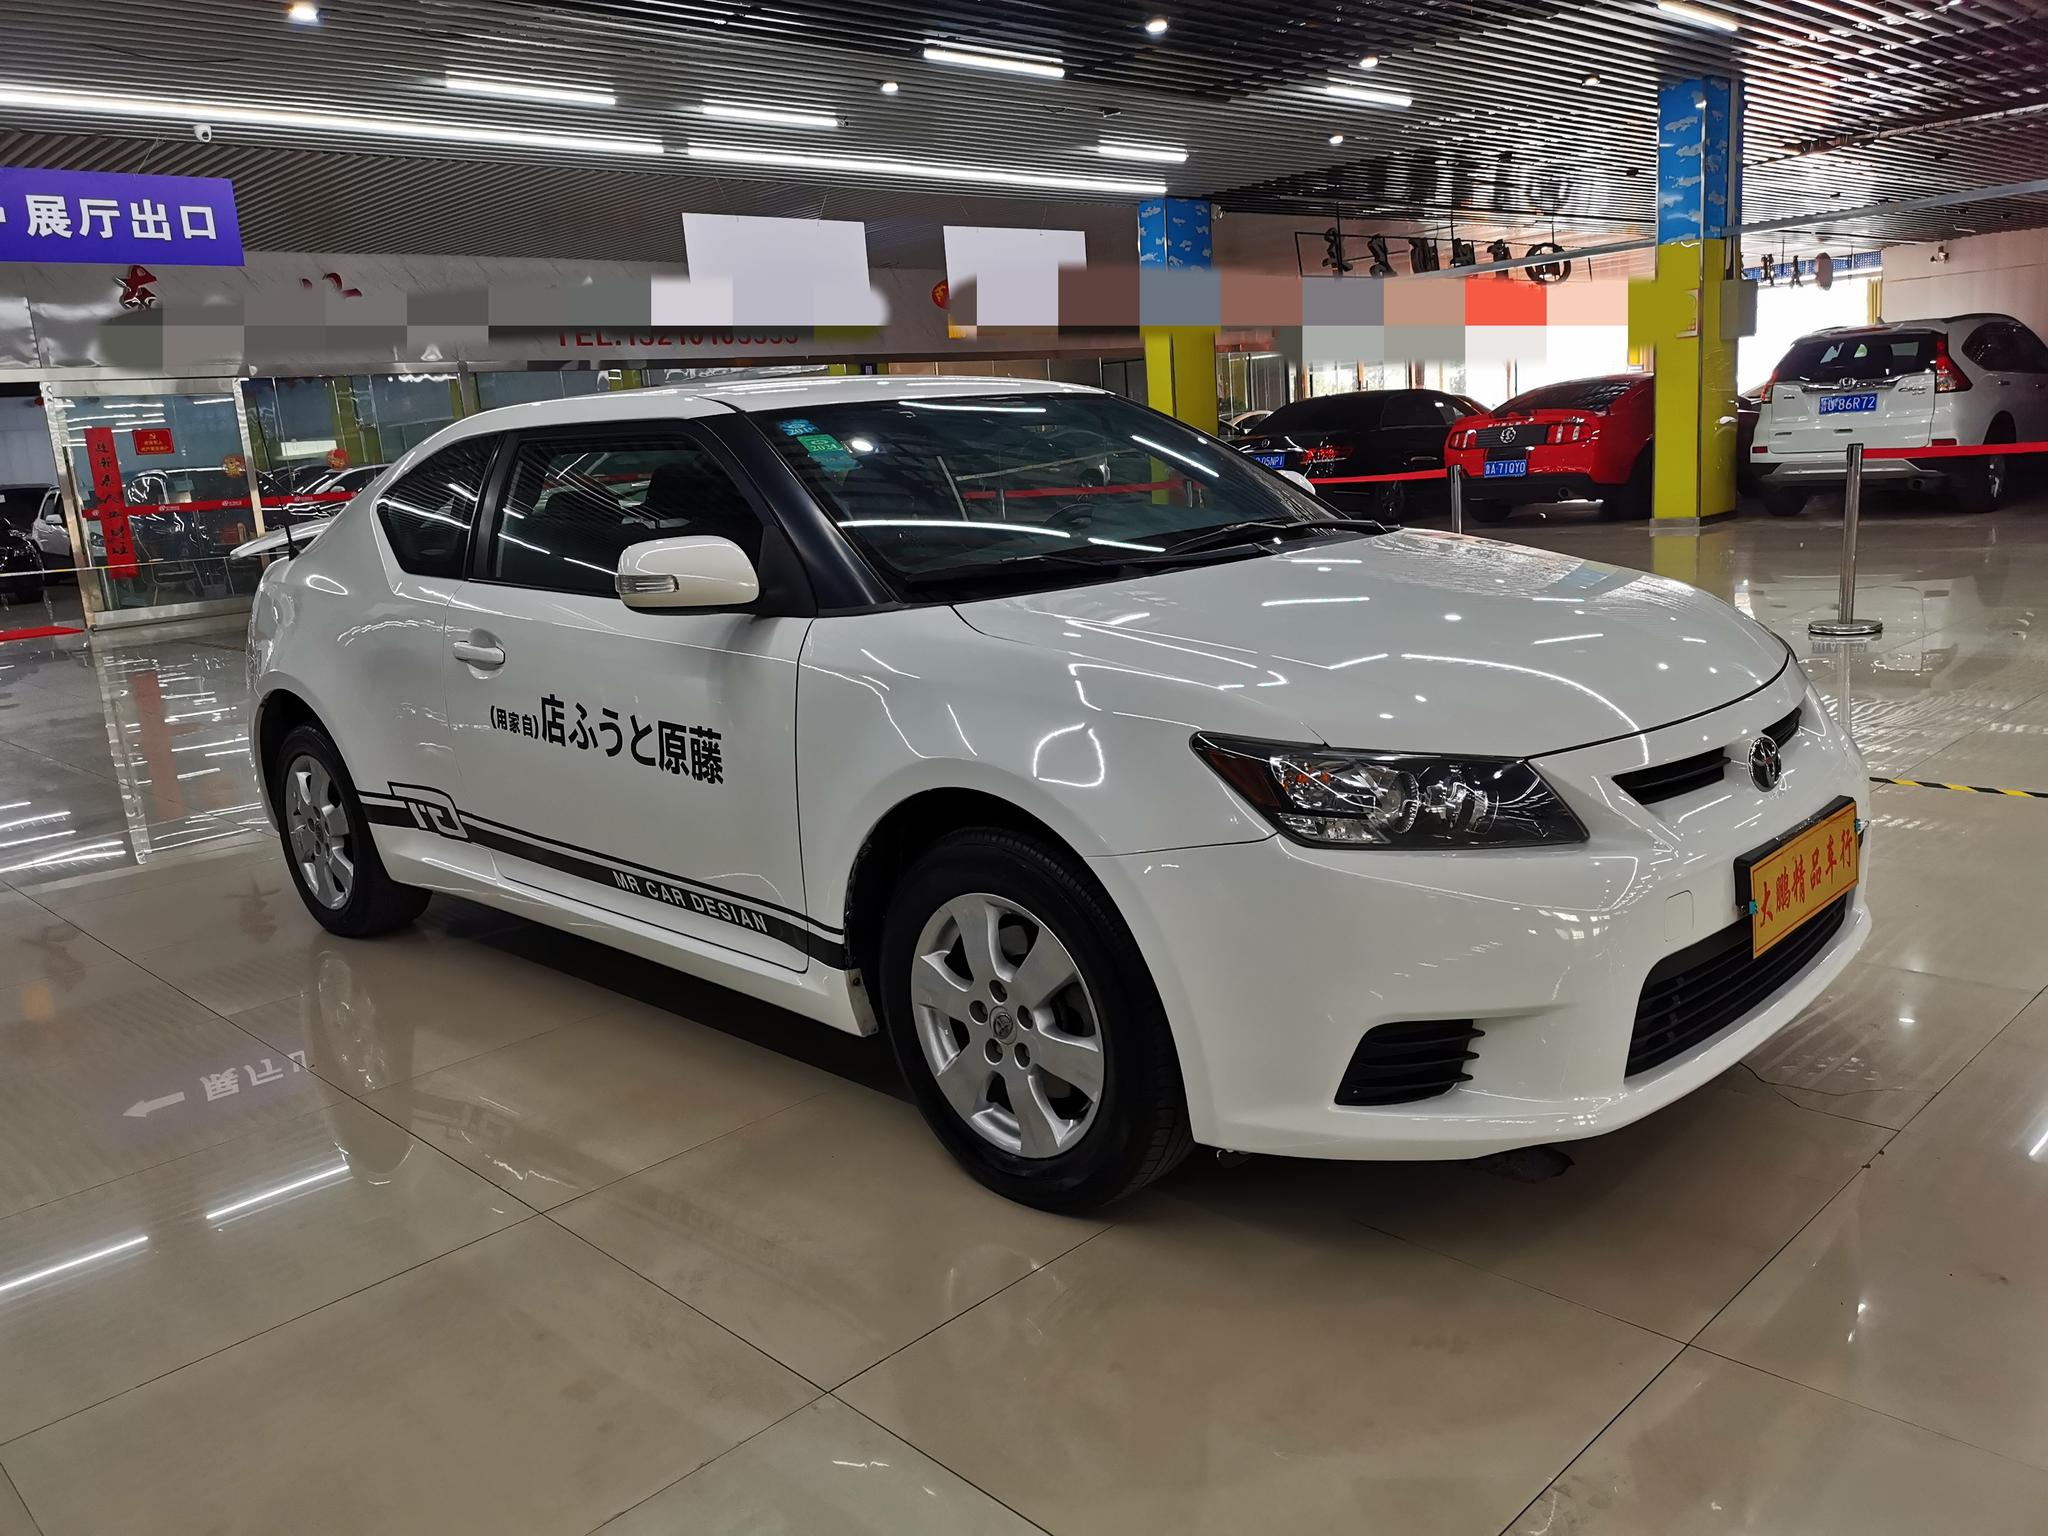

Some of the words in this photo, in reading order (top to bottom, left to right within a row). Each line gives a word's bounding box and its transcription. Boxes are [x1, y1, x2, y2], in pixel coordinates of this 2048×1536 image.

[25, 194, 217, 241] 展厅出口
[612, 870, 642, 894] MR
[645, 881, 687, 907] CAR
[690, 894, 769, 934] DESIAN
[1760, 828, 1853, 929] 大鹏精品车行
